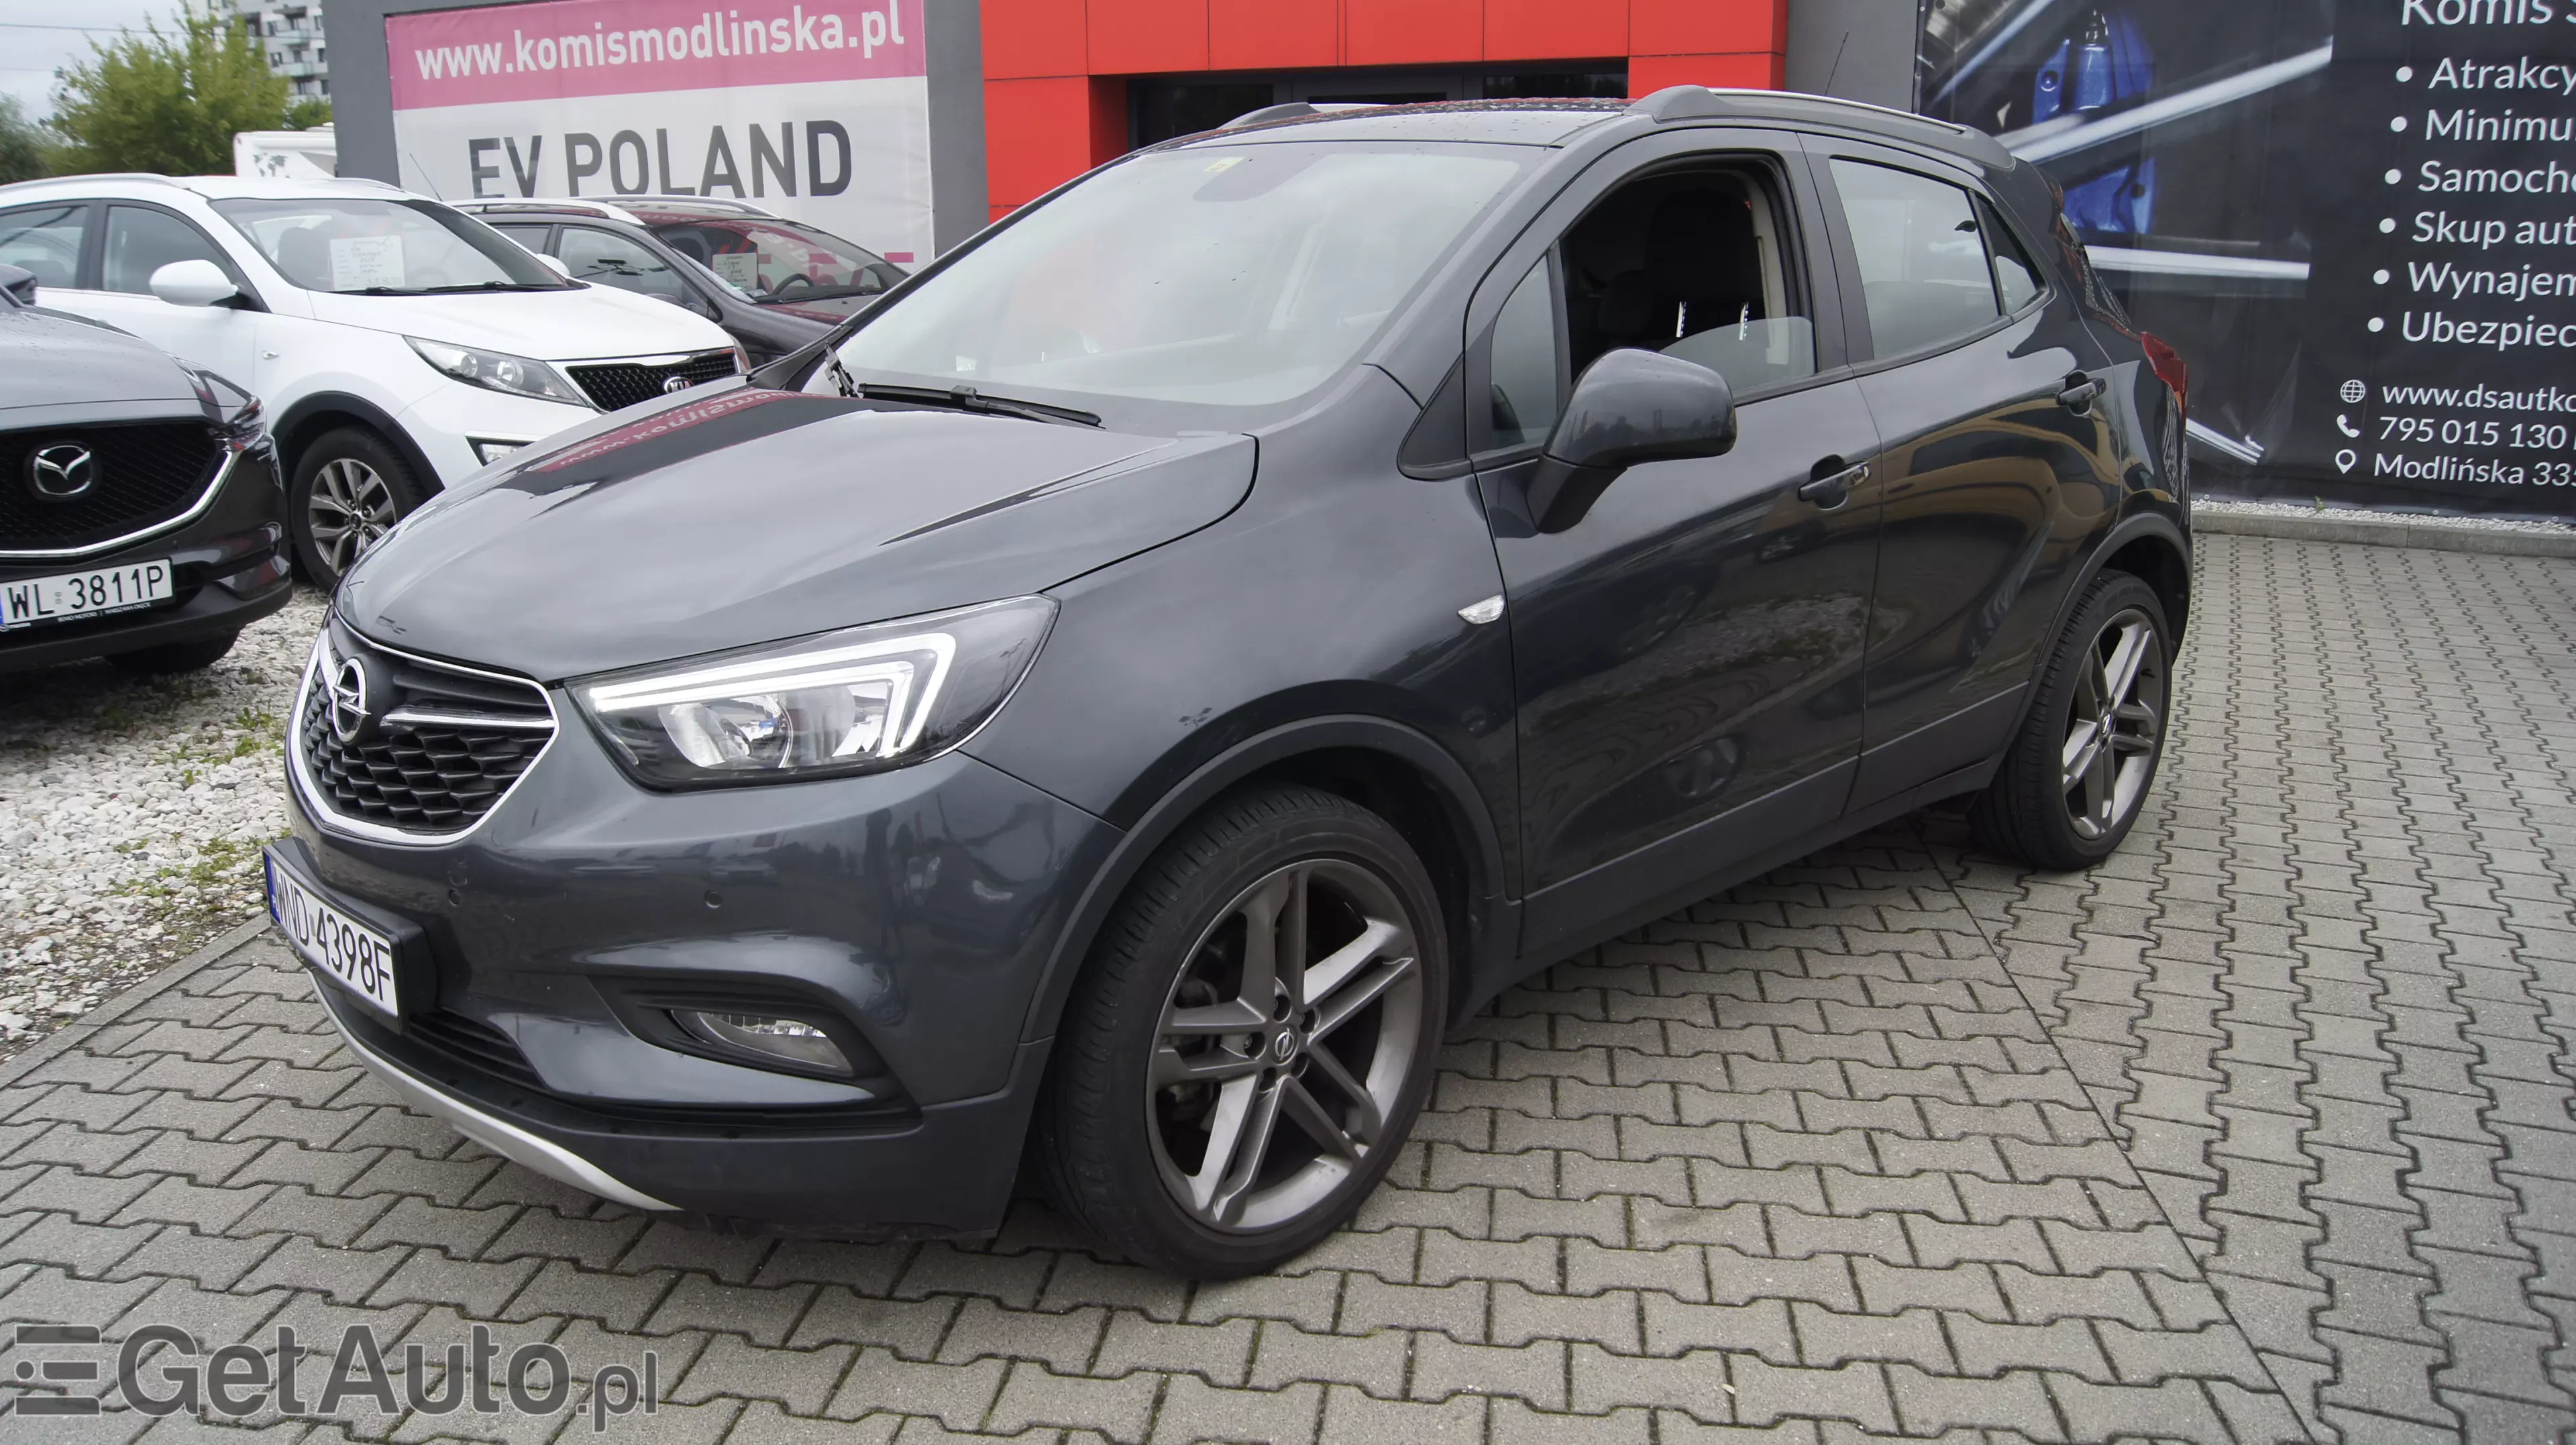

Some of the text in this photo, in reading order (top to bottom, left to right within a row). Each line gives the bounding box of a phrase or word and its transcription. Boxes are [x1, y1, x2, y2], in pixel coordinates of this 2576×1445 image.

[415, 0, 904, 80] www.komismodlinska.pl
[2425, 108, 2576, 141] Minimu
[469, 119, 851, 199] EV POLAND
[2418, 160, 2576, 193] Samoch
[2412, 211, 2506, 250] Skup
[2402, 311, 2576, 351] Ubezpiec
[2379, 416, 2434, 442] 795
[2441, 419, 2500, 447] 015
[2509, 423, 2567, 449] 130
[2373, 453, 2524, 485] Modlińska
[7, 565, 164, 619] WL 3811P
[316, 906, 390, 1001] 4398F
